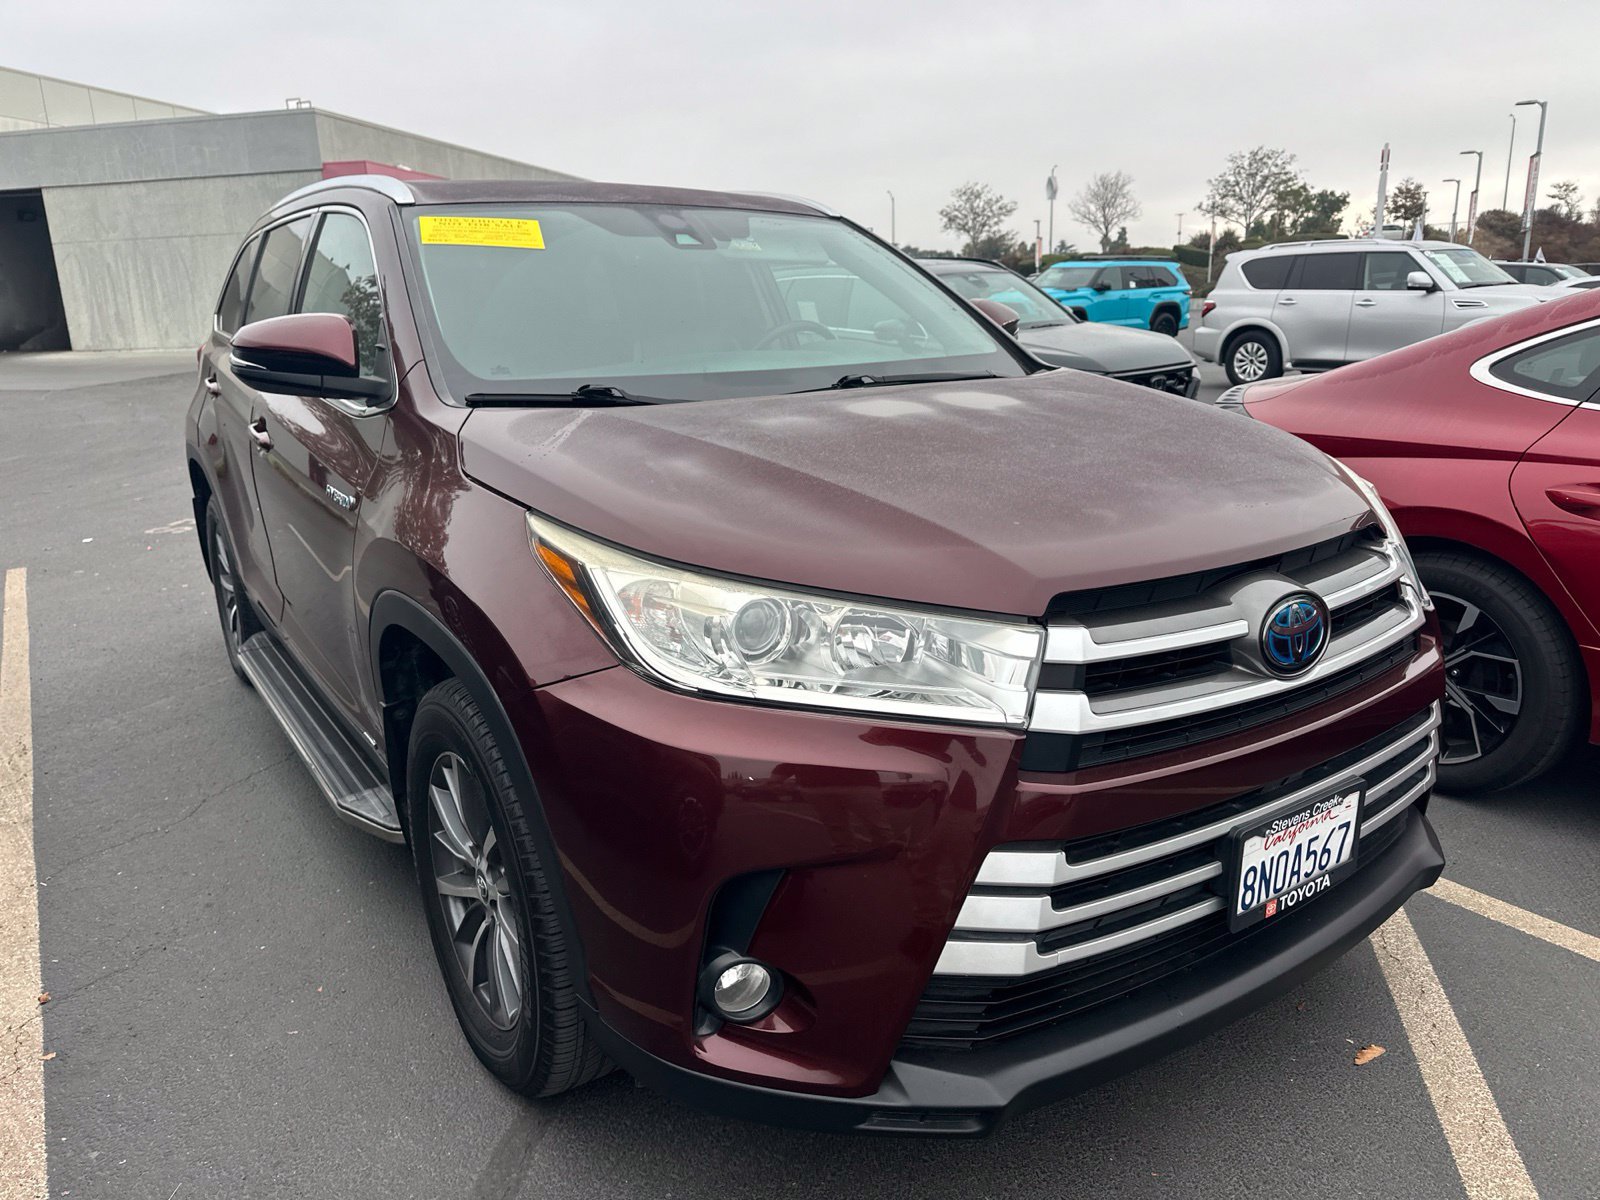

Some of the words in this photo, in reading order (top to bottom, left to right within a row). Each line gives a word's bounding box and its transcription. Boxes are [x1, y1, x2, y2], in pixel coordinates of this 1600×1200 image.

[1264, 810, 1339, 850] California
[1271, 809, 1310, 834] Stevens
[1312, 794, 1339, 816] Creek
[1241, 820, 1351, 911] 8NOA567
[1280, 874, 1330, 910] TOYOTA
